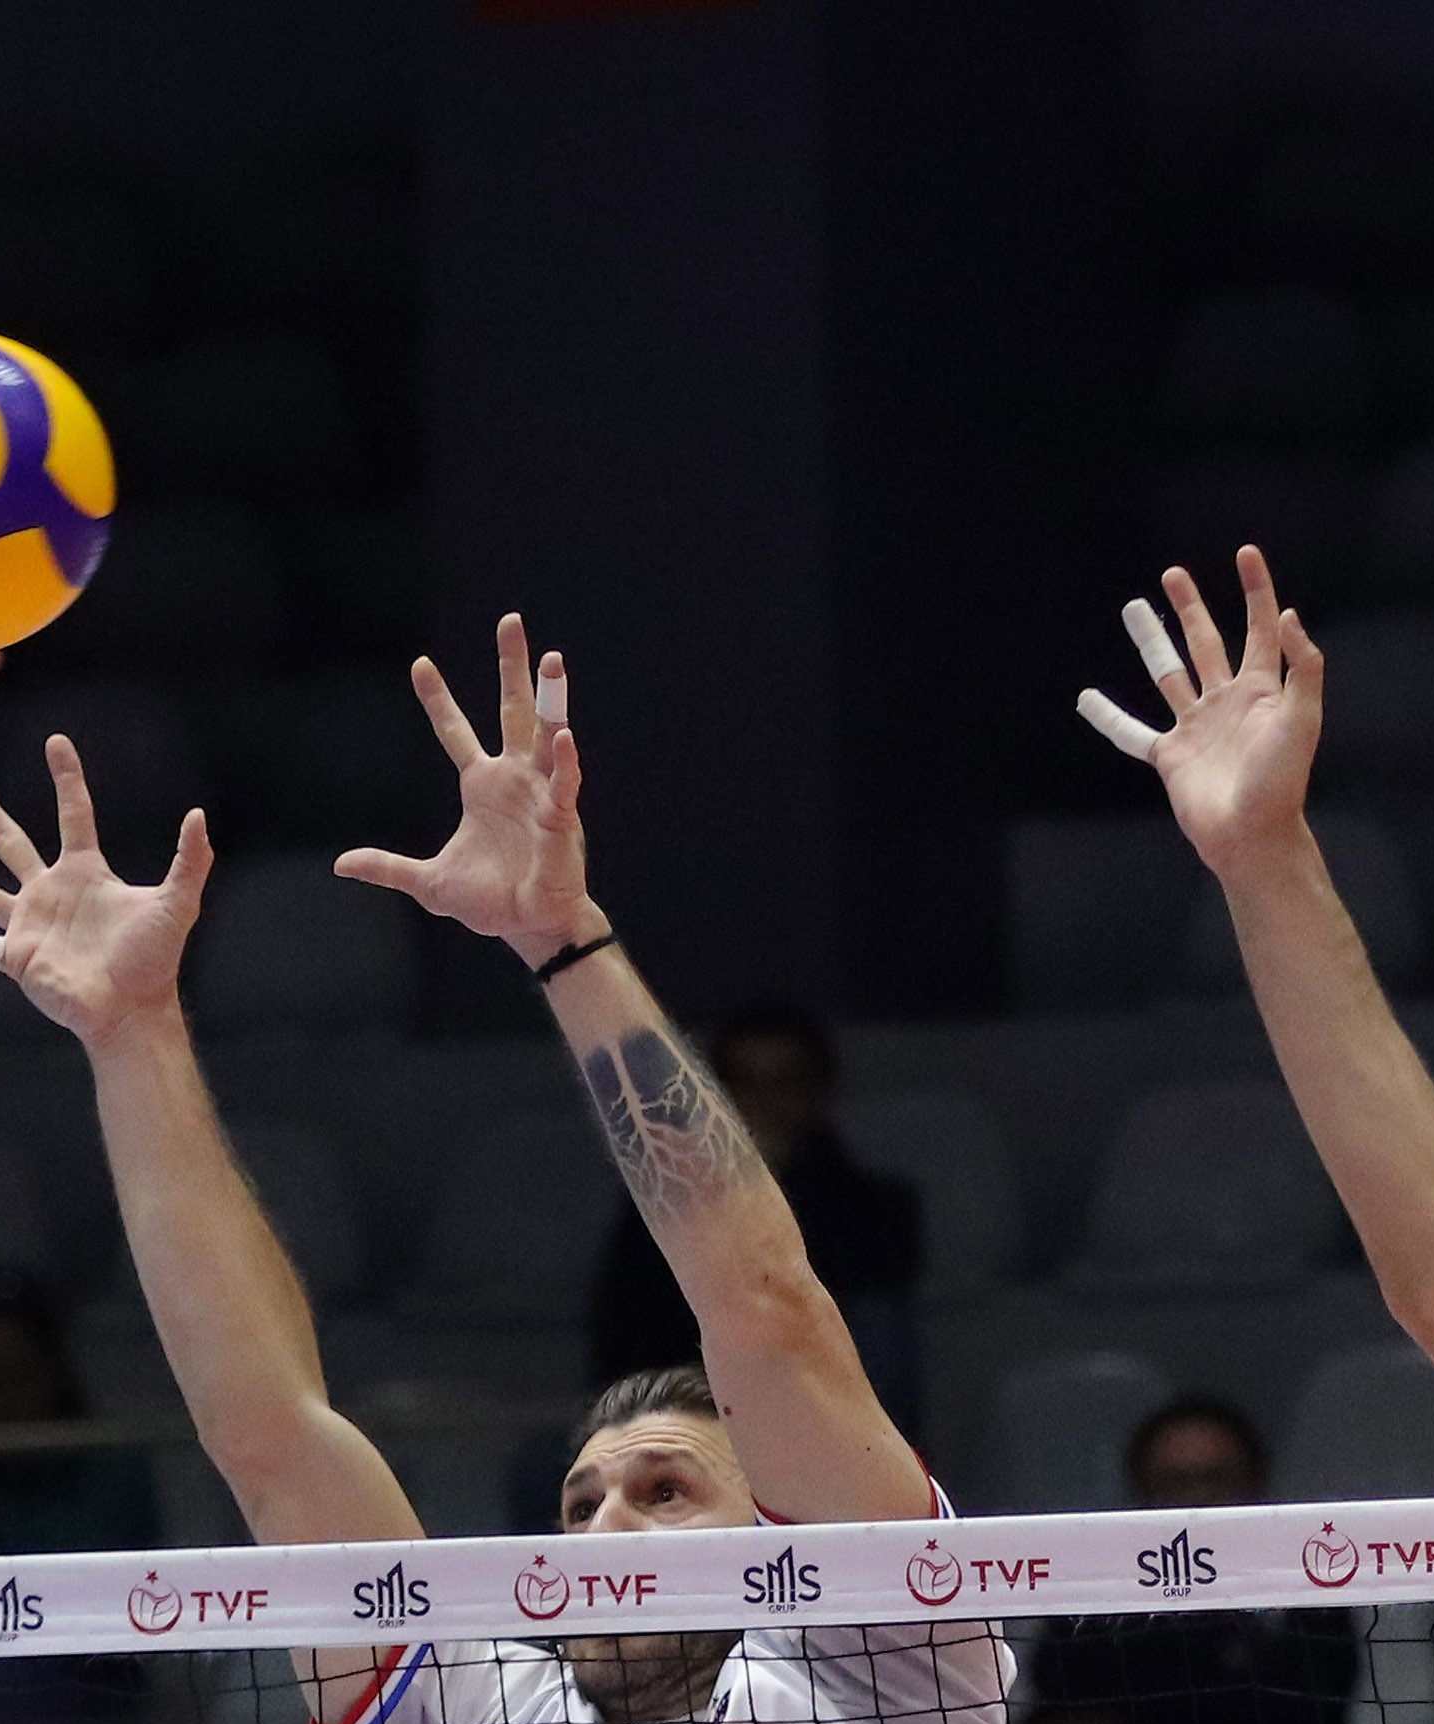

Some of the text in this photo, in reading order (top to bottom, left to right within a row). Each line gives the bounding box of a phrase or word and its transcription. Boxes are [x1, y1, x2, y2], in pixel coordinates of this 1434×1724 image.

[743, 1545, 821, 1604] SMS
[1136, 1527, 1217, 1588] SMS
[353, 1560, 430, 1619] SMS
[578, 1574, 657, 1606] TVF
[971, 1558, 1050, 1593] TVF
[1163, 1587, 1191, 1598] GRUP
[191, 1590, 268, 1623] TVF
